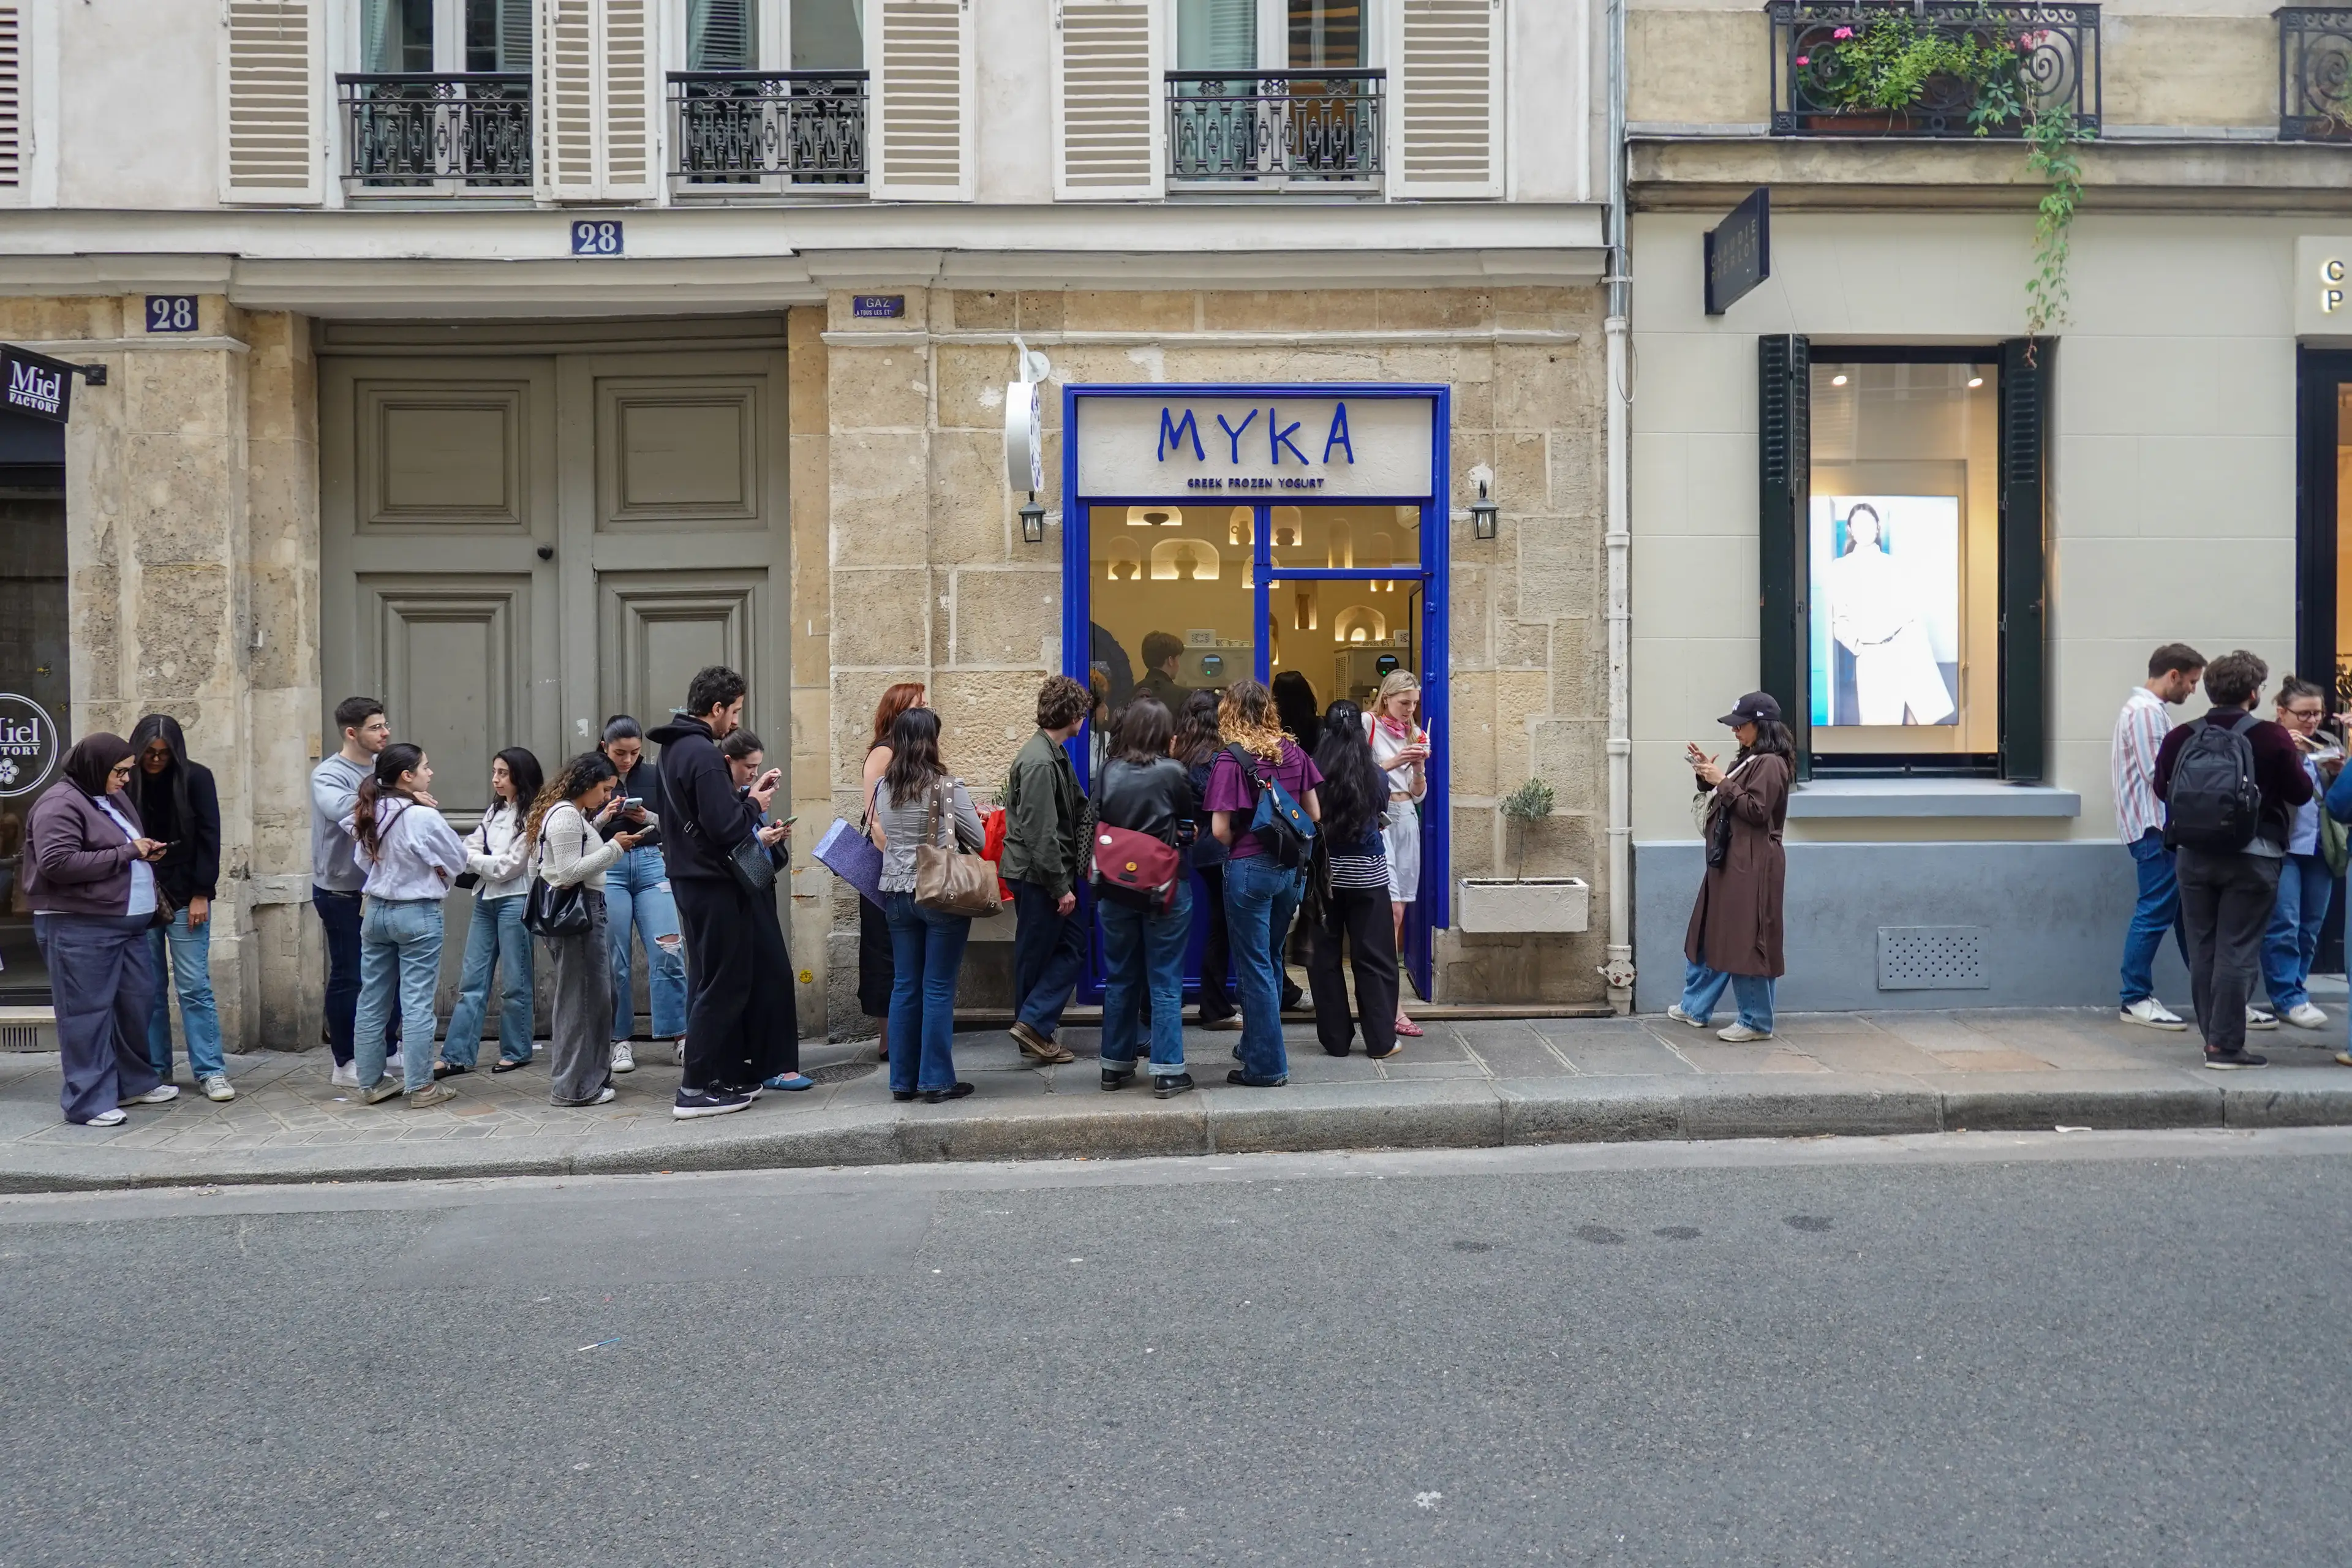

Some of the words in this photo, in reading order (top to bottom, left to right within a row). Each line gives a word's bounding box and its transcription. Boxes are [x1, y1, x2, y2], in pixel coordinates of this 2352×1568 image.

[578, 223, 617, 252] 28
[1711, 218, 1757, 268] CLAUDIE
[1711, 236, 1757, 284] PIERLOT
[153, 298, 192, 329] 28
[866, 298, 891, 307] GAZ
[9, 360, 61, 401] Miel
[9, 392, 59, 414] FACTORY
[1158, 402, 1355, 466] MYKA
[1187, 478, 1223, 488] GREEK
[1228, 478, 1272, 488] FROZEN
[1278, 478, 1325, 488] YOGURT
[0, 717, 41, 743] iel
[1, 746, 40, 756] TORY
